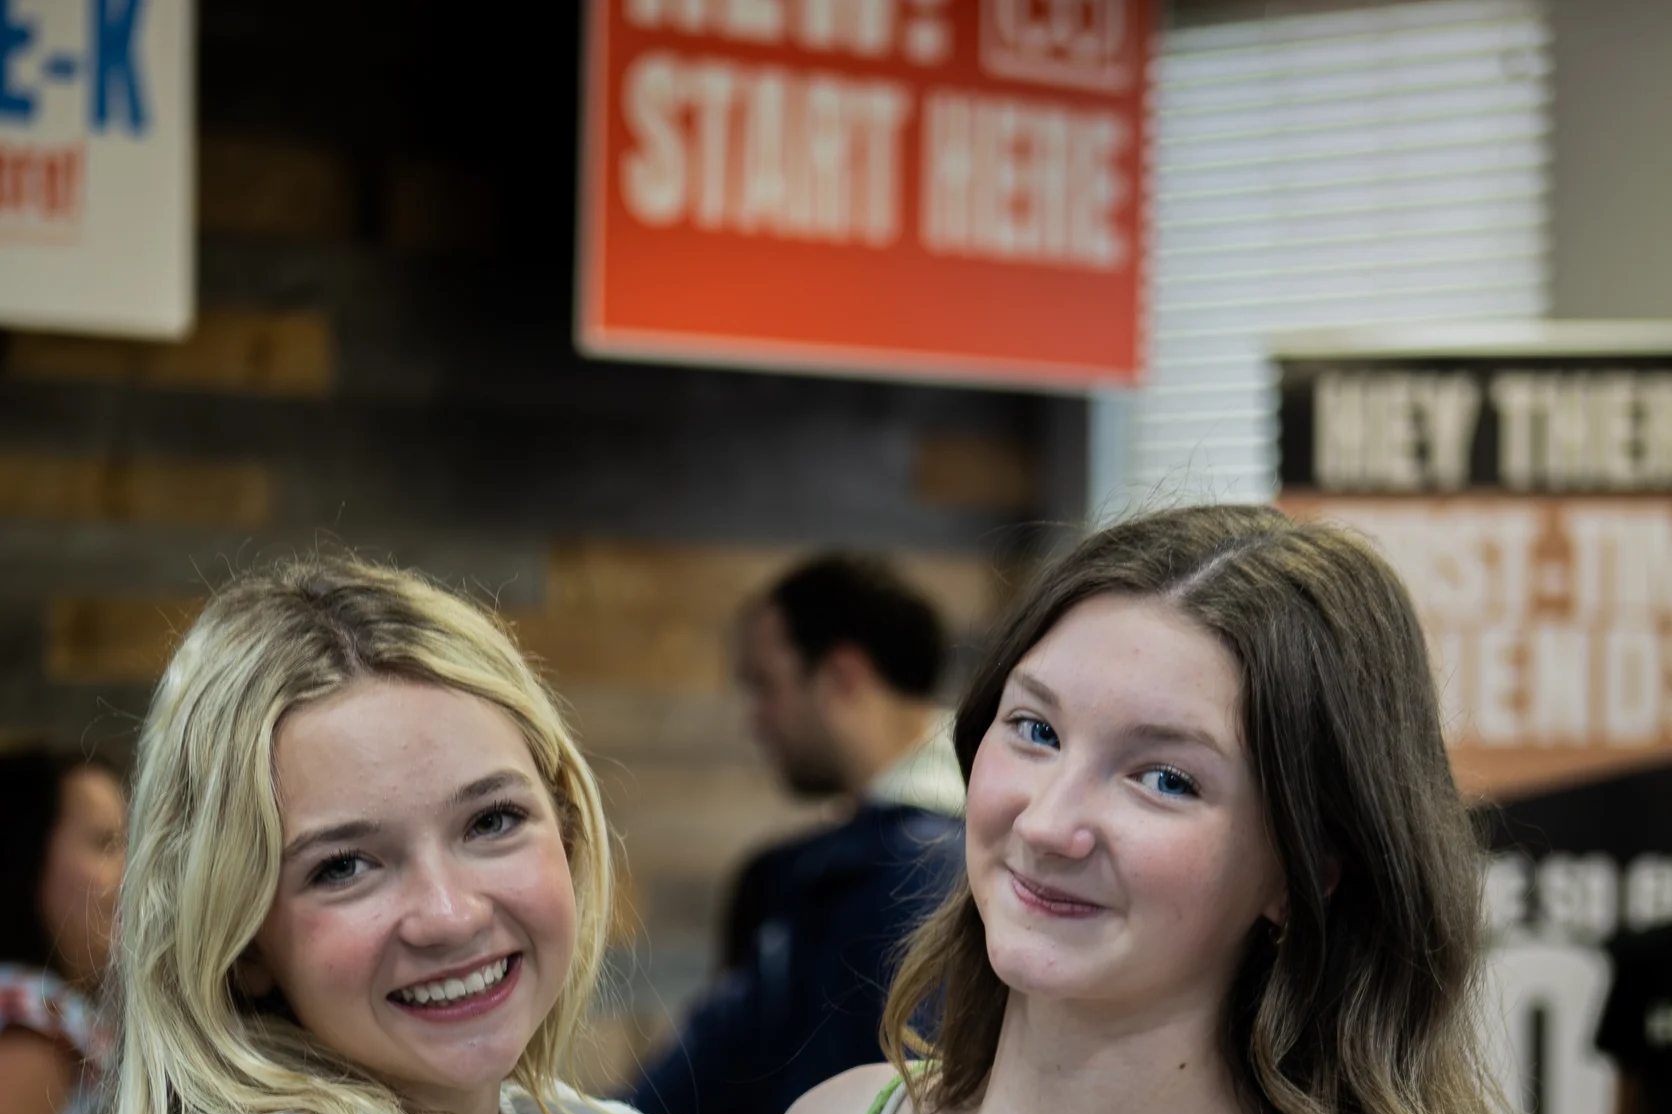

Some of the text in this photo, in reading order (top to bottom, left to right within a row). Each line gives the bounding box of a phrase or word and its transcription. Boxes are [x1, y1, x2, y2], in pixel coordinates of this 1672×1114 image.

[621, 54, 1135, 272] START HERE
[1313, 367, 1672, 492] HEY THE
